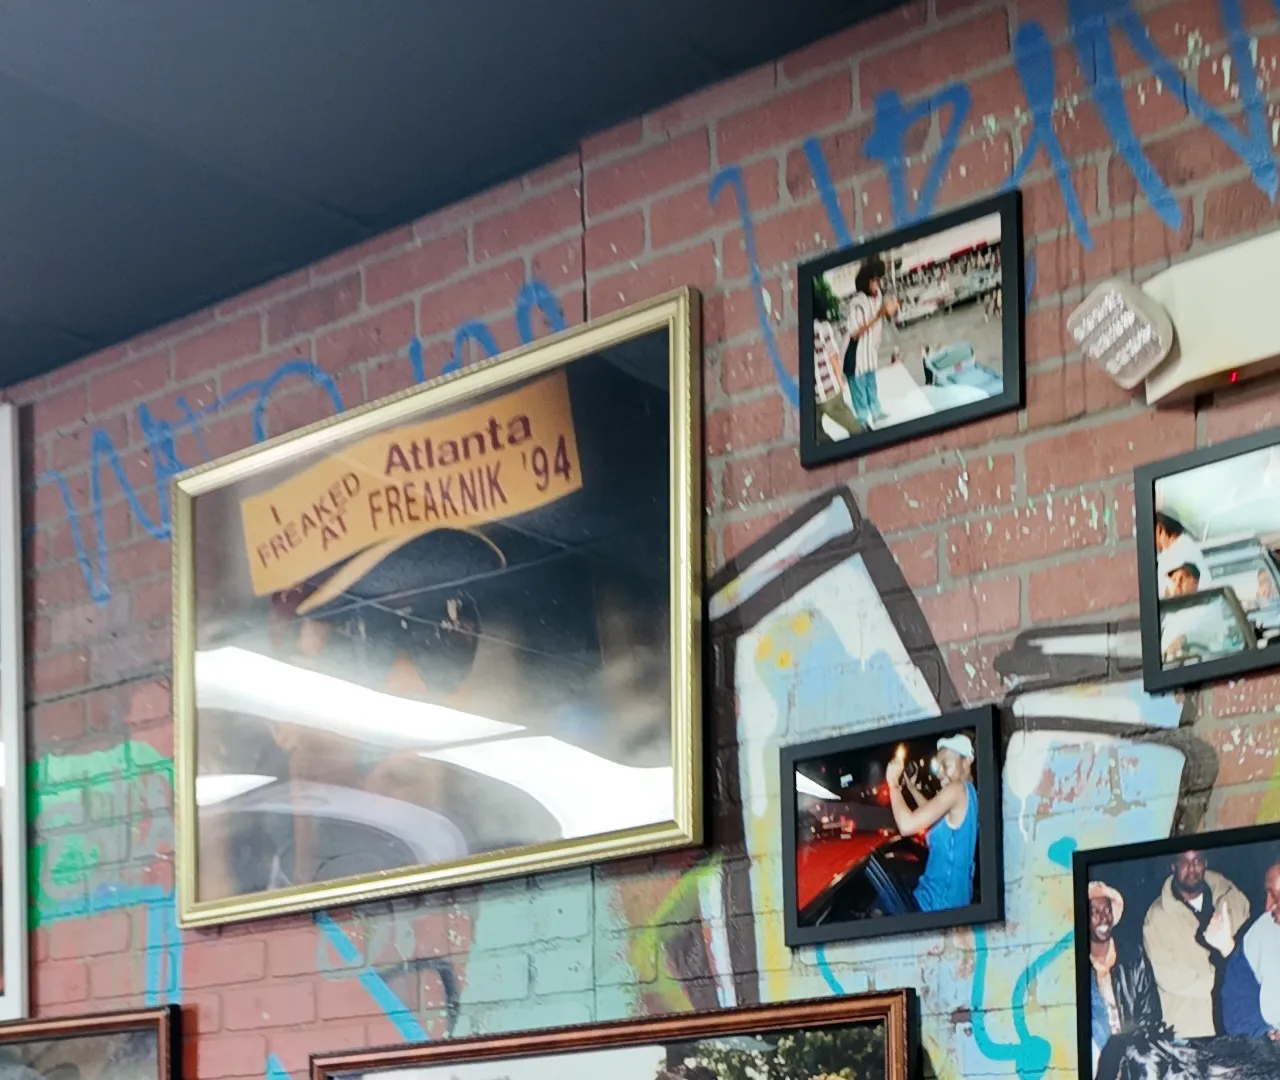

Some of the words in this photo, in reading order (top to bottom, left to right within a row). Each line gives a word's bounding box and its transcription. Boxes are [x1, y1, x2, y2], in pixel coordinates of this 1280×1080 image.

[384, 412, 534, 476] Atlanta
[270, 504, 282, 525] I
[368, 461, 509, 532] FREAKNIK
[521, 433, 573, 493] '94
[255, 471, 362, 568] FREAKED
[321, 516, 350, 551] AT
